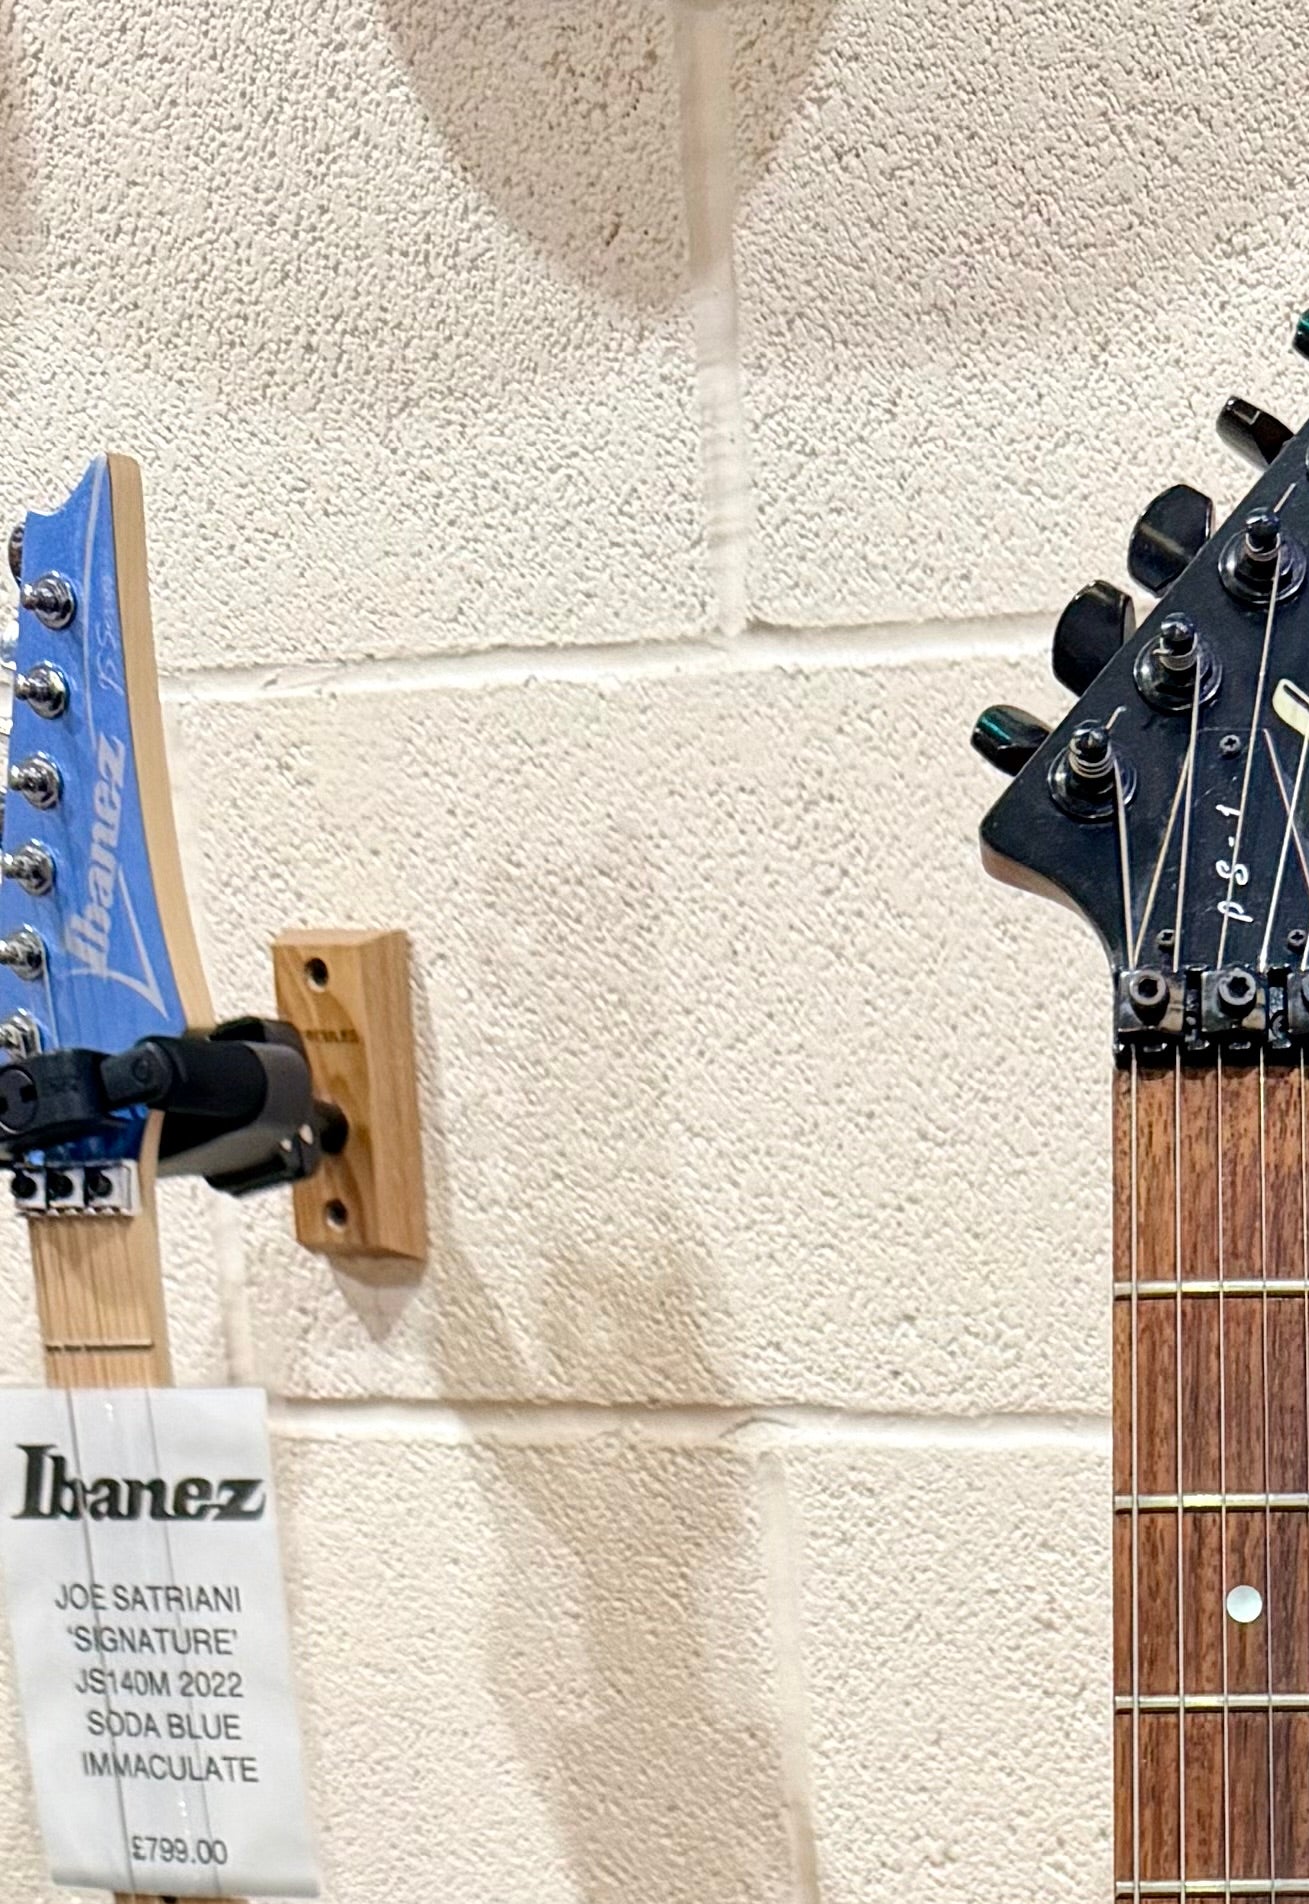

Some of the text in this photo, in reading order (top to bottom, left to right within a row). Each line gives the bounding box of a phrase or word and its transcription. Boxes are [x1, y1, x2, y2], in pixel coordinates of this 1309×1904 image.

[65, 732, 128, 980] Ibanez
[12, 1443, 267, 1521] Ibanez
[54, 1583, 242, 1613] JOE SATRIANI
[75, 1670, 245, 1698] JS140M 2022
[87, 1711, 242, 1740] SODA BLUE
[82, 1750, 259, 1782] IMMACULATE
[131, 1836, 229, 1865] £799.00
